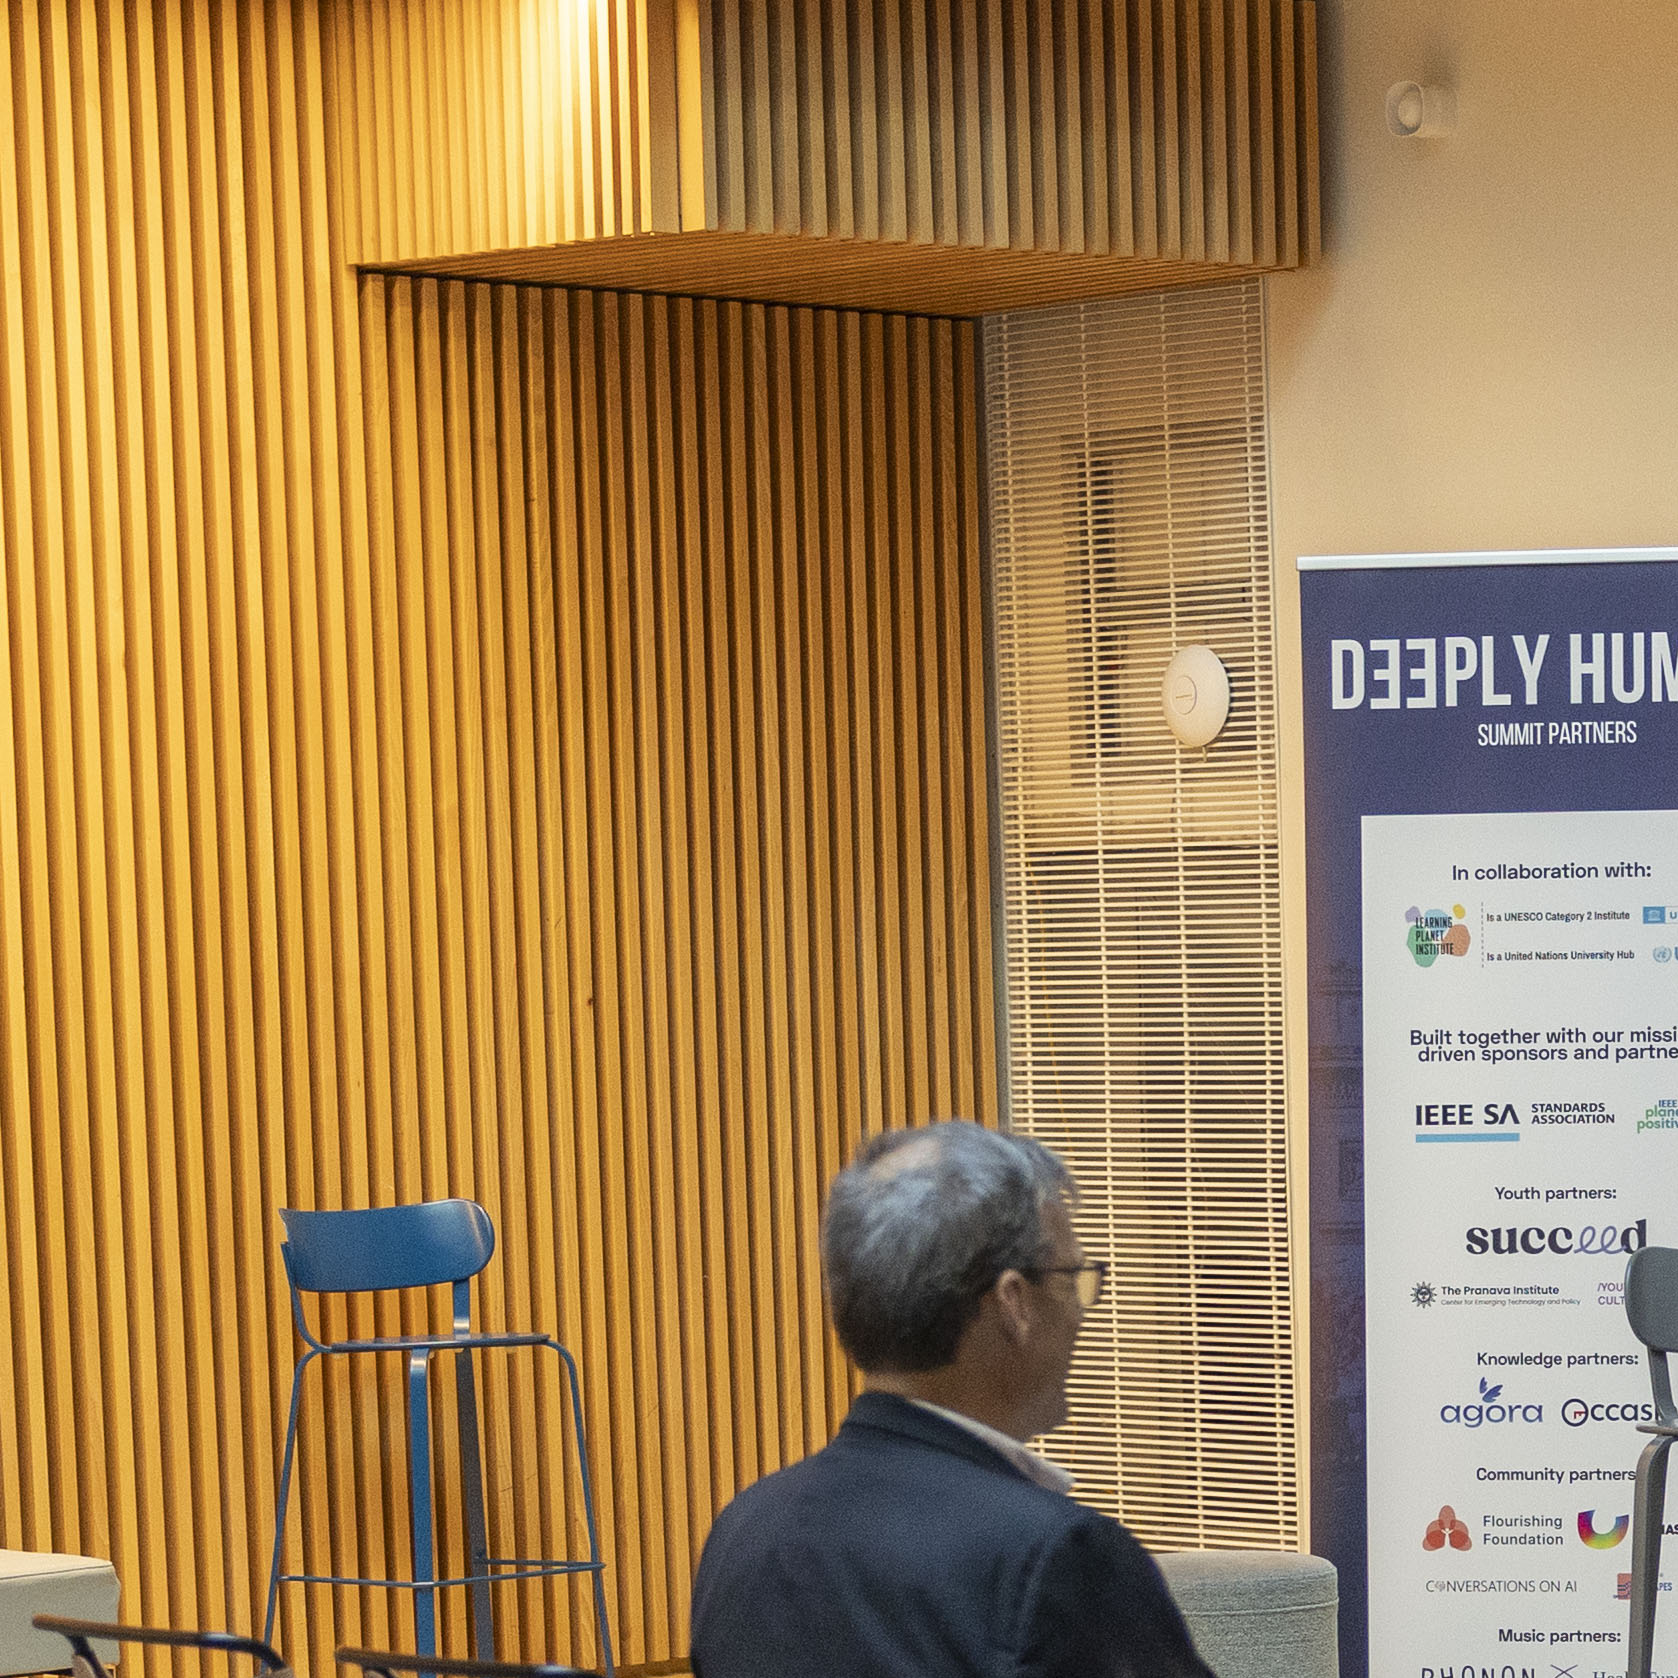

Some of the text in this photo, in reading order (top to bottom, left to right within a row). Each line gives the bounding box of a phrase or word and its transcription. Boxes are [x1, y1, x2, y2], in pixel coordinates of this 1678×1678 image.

[1477, 720, 1638, 746] SUMMIT PARTNERS
[1452, 861, 1652, 881] In collaboration with:
[1415, 916, 1453, 929] LEARNING
[1486, 910, 1630, 923] Is a UNESCO Category 2 Institute
[1415, 930, 1444, 942] PLANET
[1415, 943, 1454, 955] INSTITUTE
[1486, 949, 1635, 962] Is a United Nations University Hub
[1410, 1029, 1452, 1046] Built
[1458, 1028, 1540, 1049] together
[1546, 1027, 1586, 1044] with
[1592, 1030, 1624, 1043] our
[1418, 1046, 1475, 1062] driven
[1481, 1047, 1567, 1065] sponsors
[1574, 1045, 1609, 1060] and
[1531, 1102, 1606, 1113] STANDARDS
[1658, 1099, 1678, 1108] IEEE
[1415, 1104, 1473, 1126] IEEE
[1531, 1113, 1615, 1124] ASSOCIATION
[1495, 1186, 1617, 1203] Youth partners:
[1466, 1219, 1647, 1255] succeed
[1441, 1284, 1559, 1296] The Pranava Institute
[1477, 1352, 1639, 1368] Knowledge partners:
[1440, 1403, 1543, 1428] agora
[1476, 1467, 1565, 1484] Community
[1483, 1515, 1563, 1530] Flourishing
[1483, 1533, 1564, 1546] Foundation
[1539, 1580, 1561, 1592] ON
[1564, 1580, 1577, 1592] AI
[1498, 1629, 1621, 1646] Music partners:
